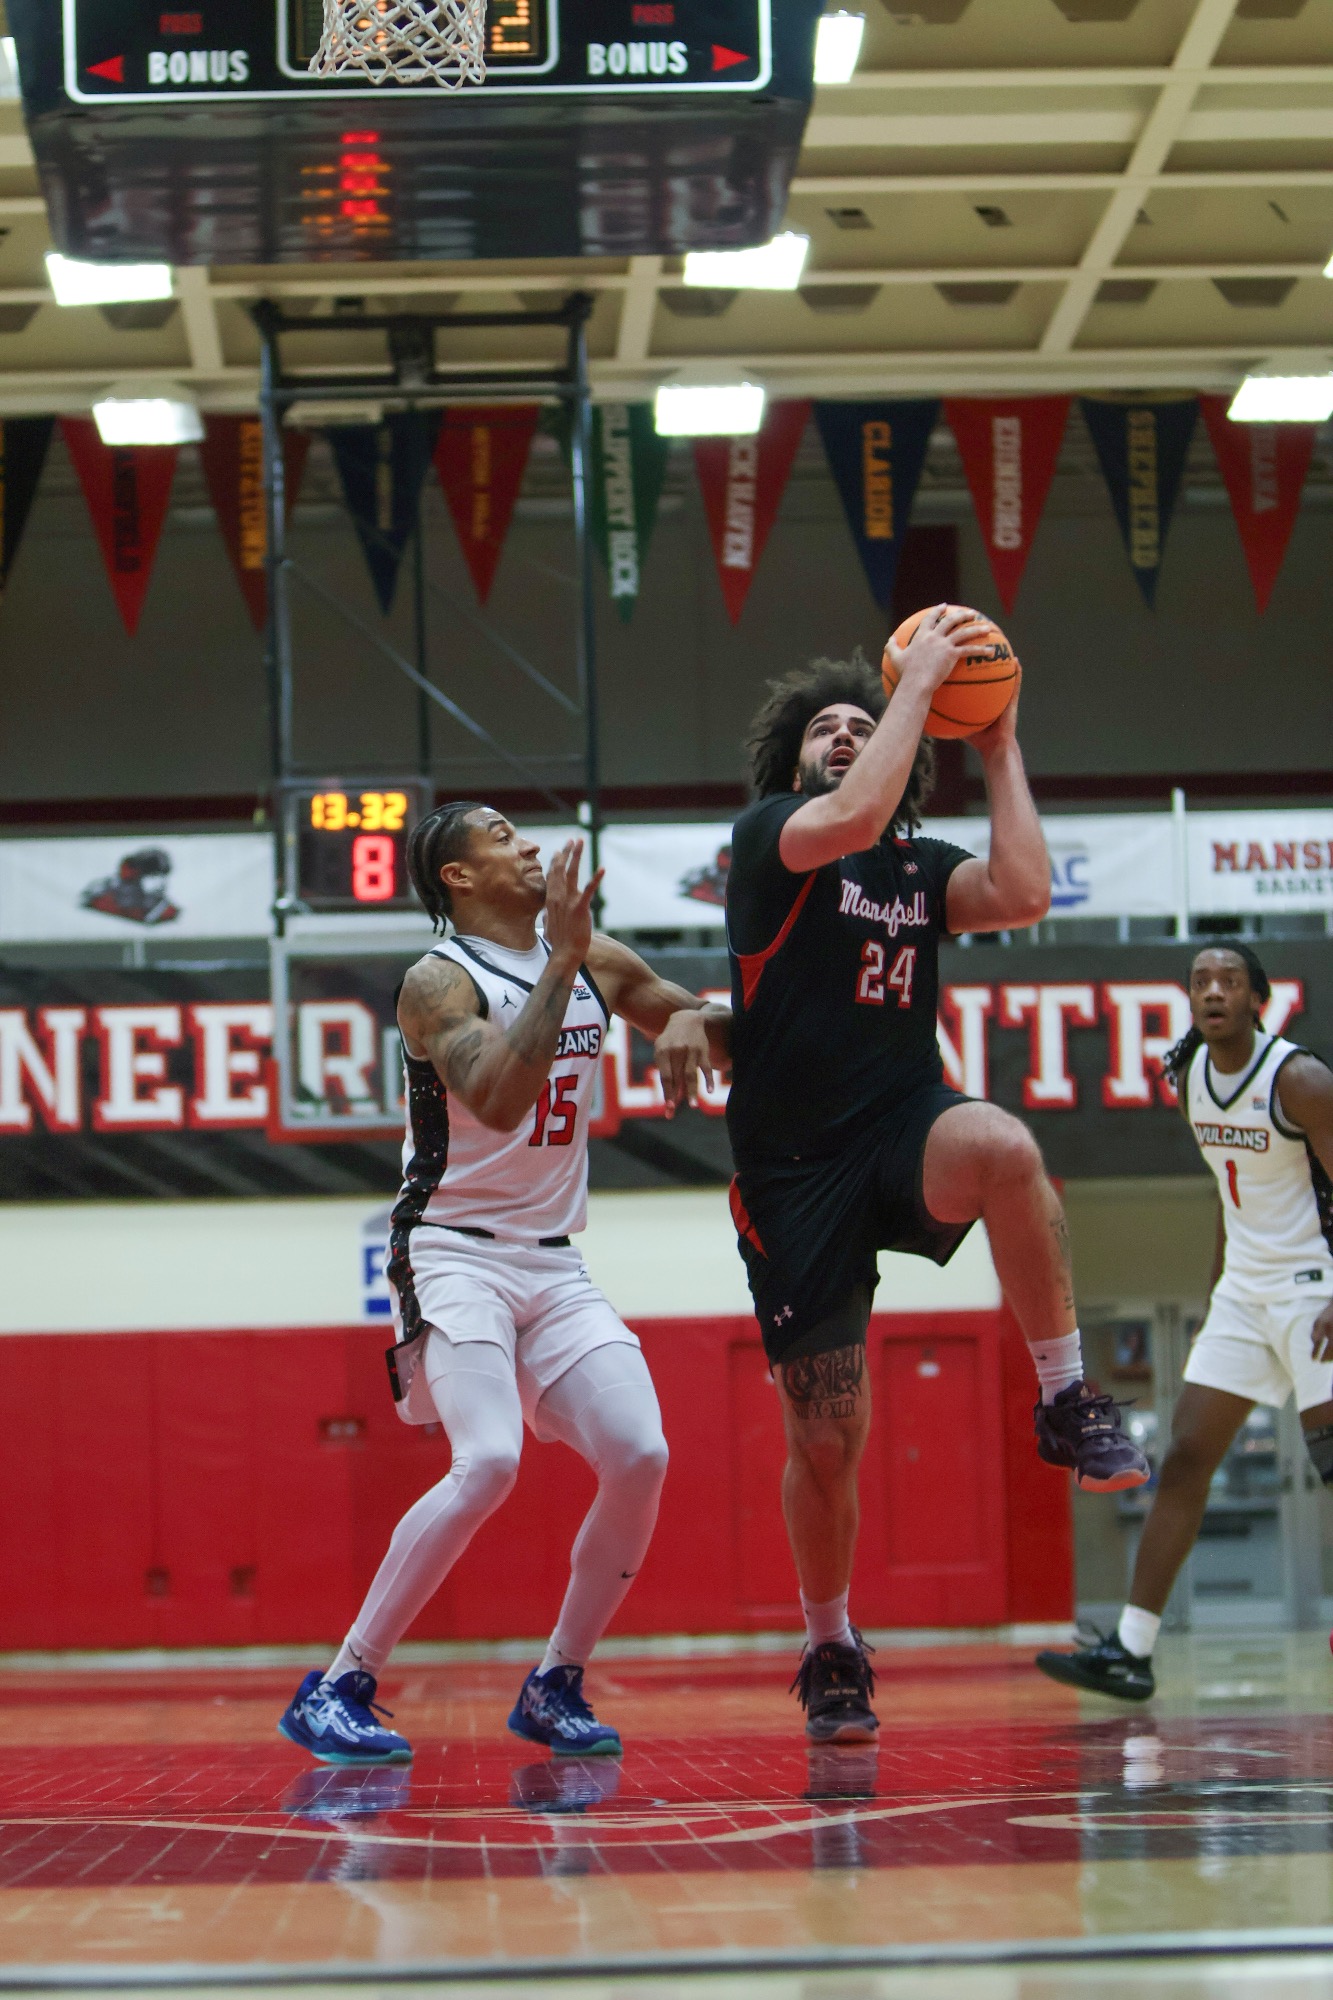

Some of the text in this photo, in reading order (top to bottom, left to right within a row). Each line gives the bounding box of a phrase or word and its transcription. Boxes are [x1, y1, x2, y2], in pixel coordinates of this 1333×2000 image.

[148, 50, 249, 84] BONUS
[587, 41, 689, 76] BONUS
[862, 420, 894, 540] CLARION
[608, 530, 640, 597] ROCK
[353, 835, 394, 902] 8
[1212, 841, 1333, 873] MANS
[855, 939, 917, 1009] 24
[528, 1074, 578, 1147] 15
[1196, 1124, 1270, 1151] VULCANS
[1225, 1159, 1243, 1210] 1
